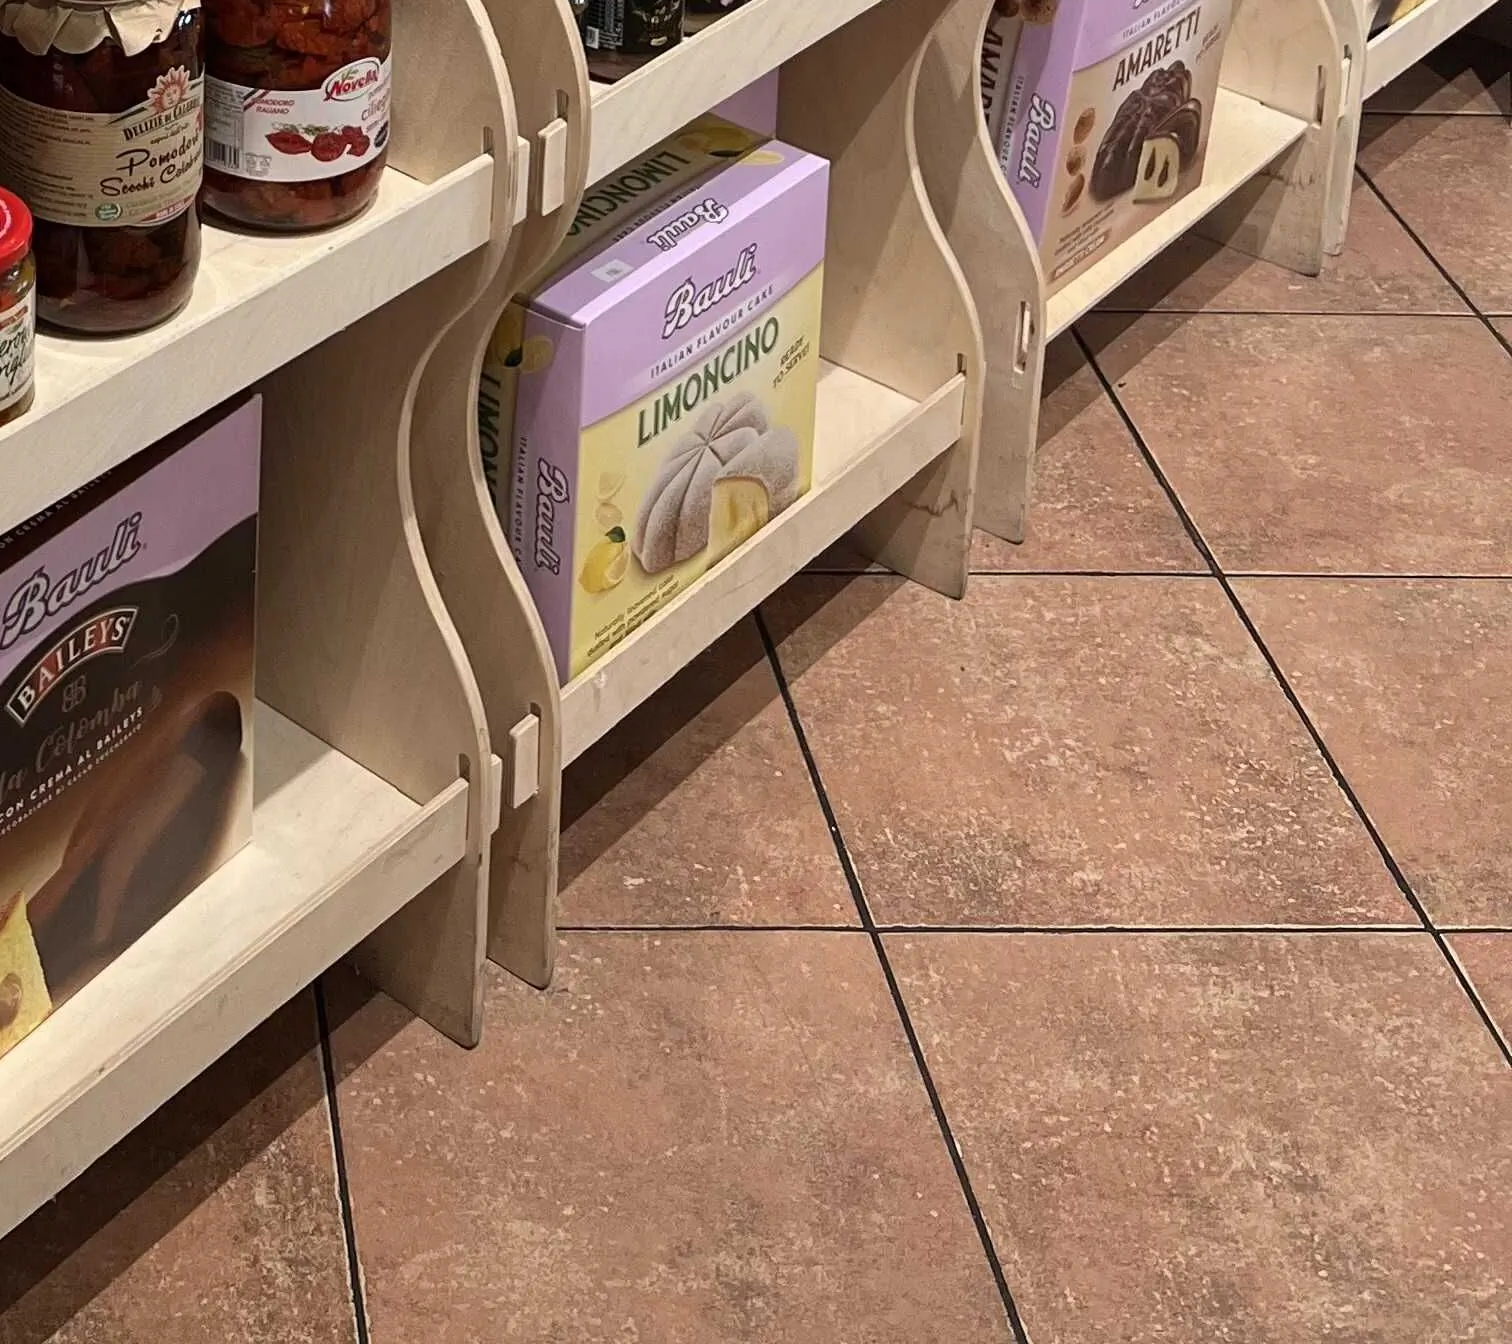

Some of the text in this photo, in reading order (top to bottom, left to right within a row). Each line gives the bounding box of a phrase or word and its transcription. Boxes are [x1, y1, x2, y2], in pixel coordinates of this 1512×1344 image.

[324, 67, 379, 101] Novella
[1112, 6, 1202, 92] AMARETTI
[123, 117, 163, 141] DELIZIE
[1017, 93, 1056, 188] Bauli
[646, 197, 729, 251] Bauli
[650, 284, 774, 378] ITALIAN FLAVOUR CAKE
[662, 242, 758, 340] Bauli
[636, 315, 780, 448] LIMONCINO
[534, 457, 570, 576] Bauli
[0, 511, 144, 650] Bauli
[17, 615, 129, 711] BAILEYS
[30, 764, 72, 801] CREMA
[77, 750, 92, 765] AL
[96, 706, 144, 750] BAILEYS
